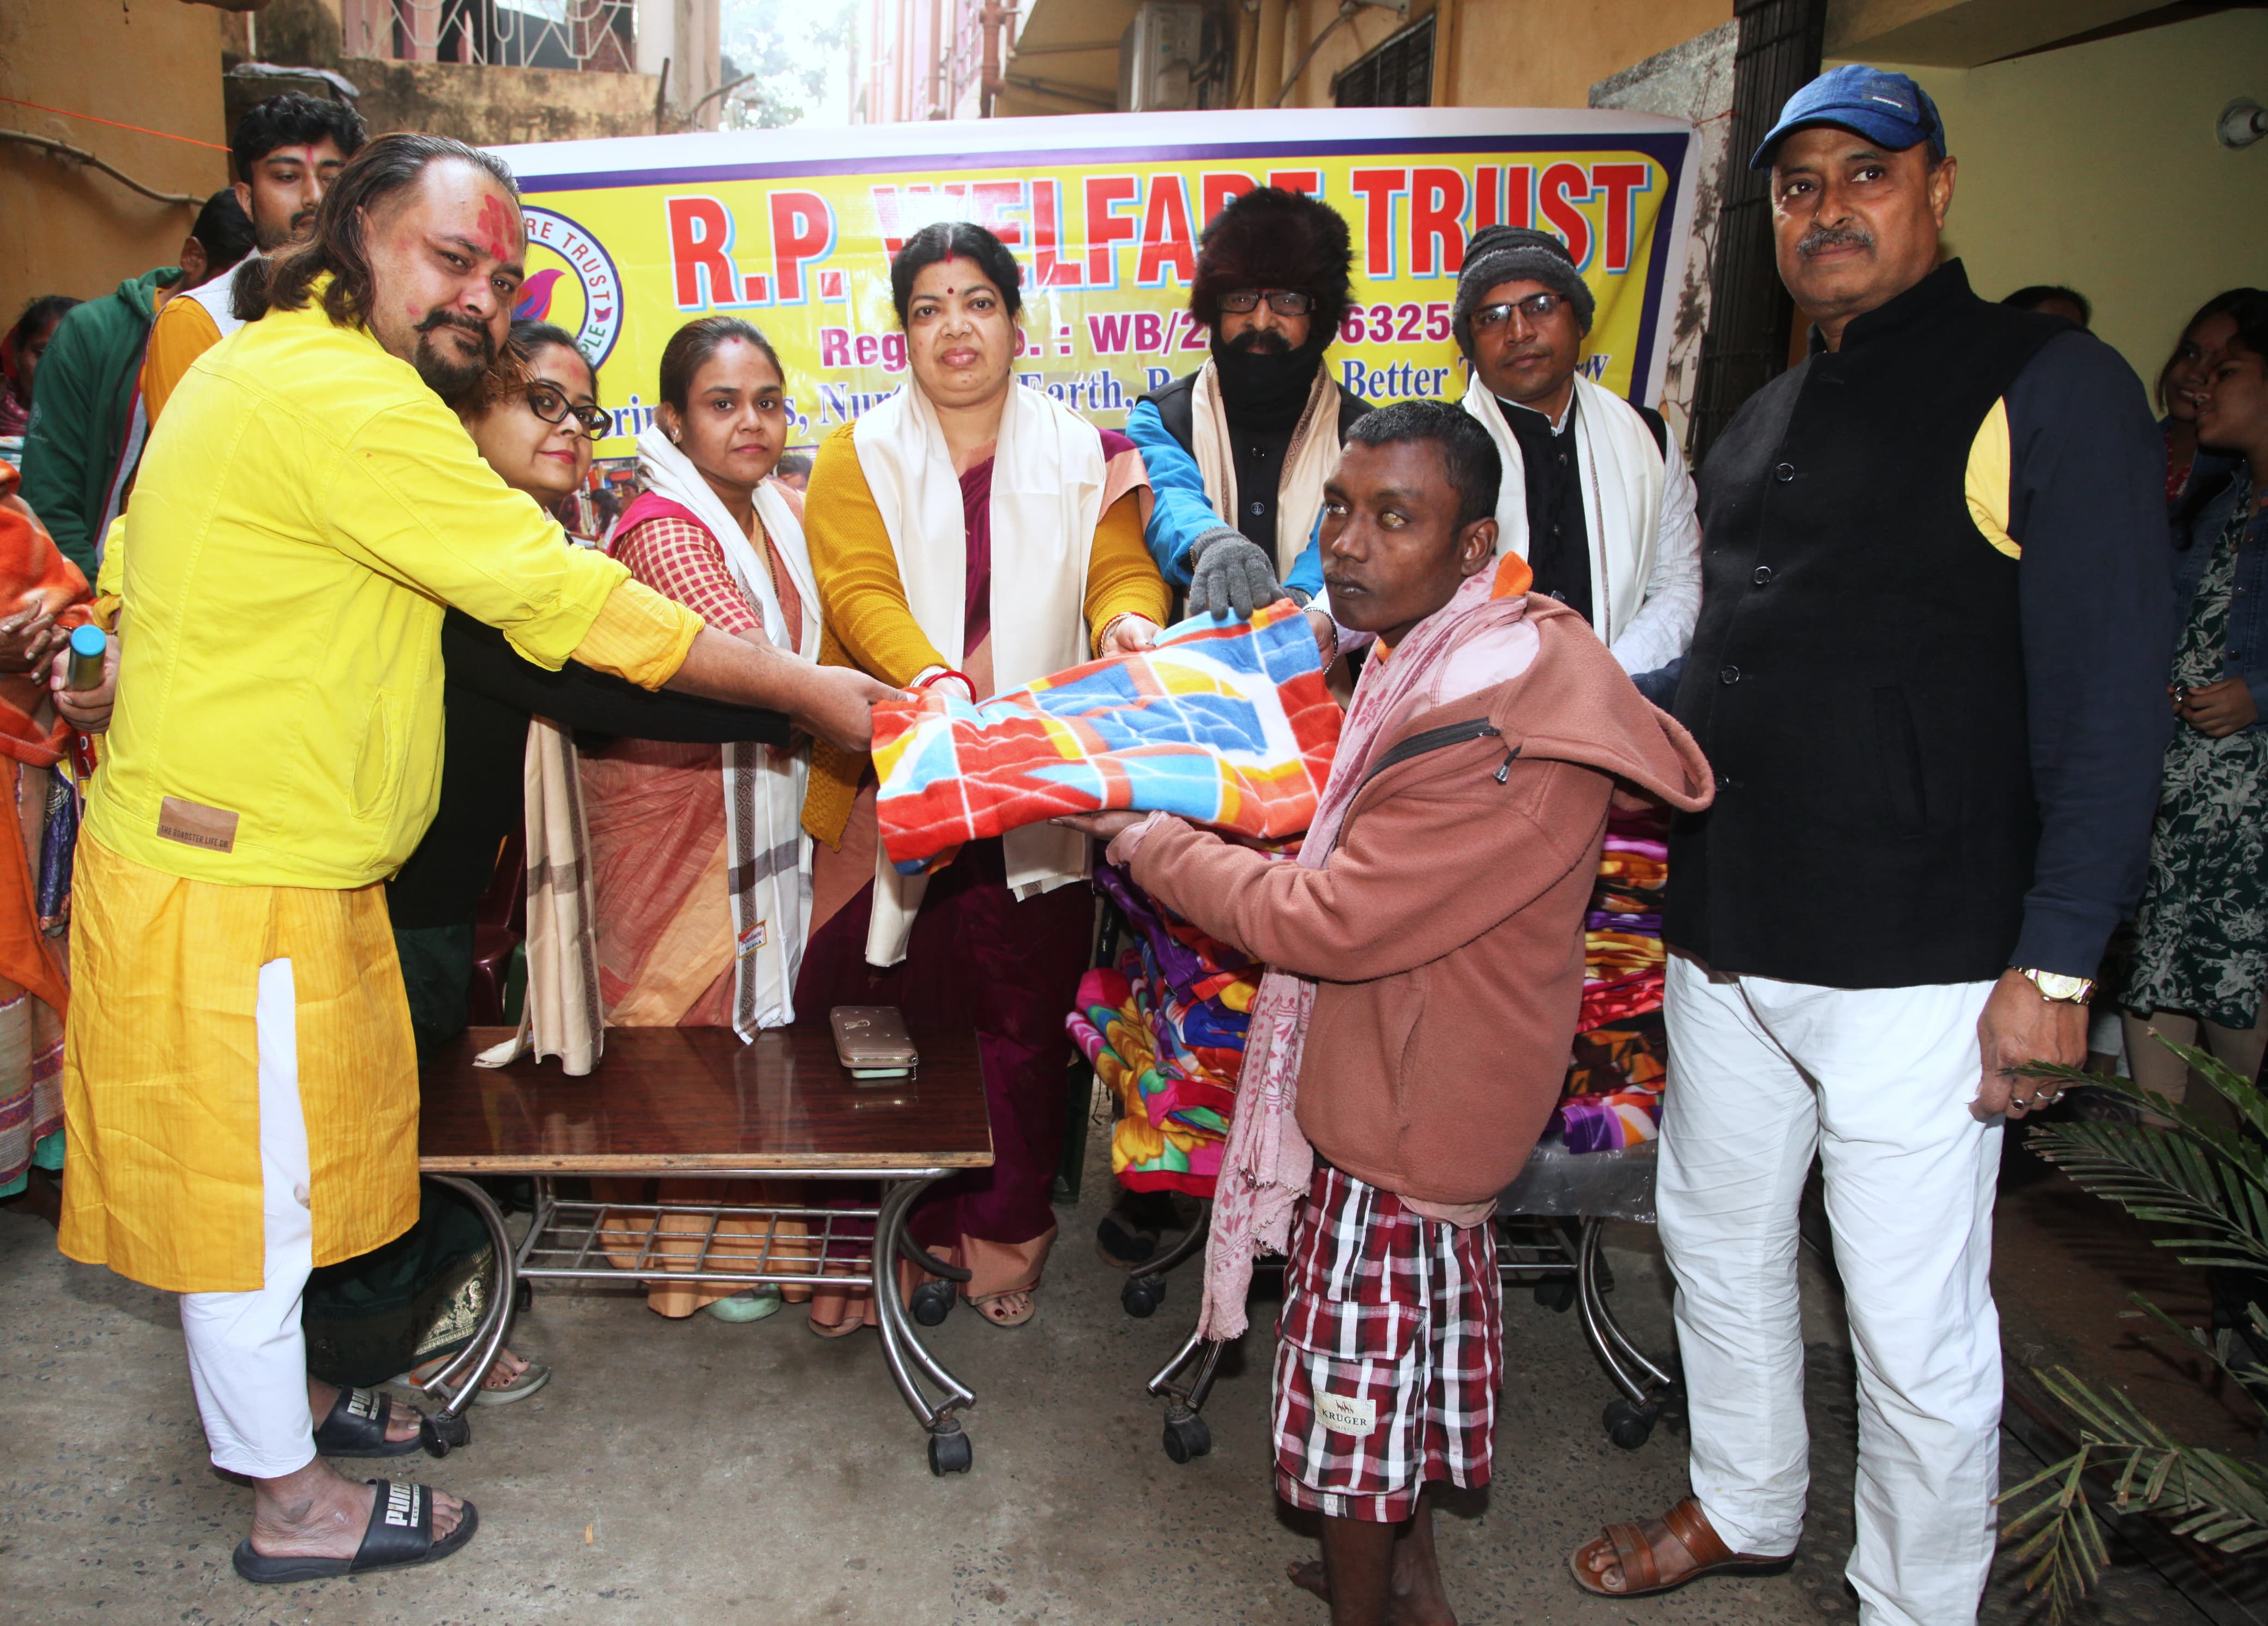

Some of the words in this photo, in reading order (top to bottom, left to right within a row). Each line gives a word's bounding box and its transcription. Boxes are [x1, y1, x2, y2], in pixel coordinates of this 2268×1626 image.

[666, 190, 845, 311] R.P.
[1350, 161, 1651, 280] TRUST
[562, 232, 611, 302] TRUST
[821, 328, 908, 373] Reg
[1341, 359, 1449, 399] Better
[161, 825, 172, 835] THE
[173, 829, 203, 844] ROADSTER
[204, 836, 218, 847] LIFE
[385, 1482, 410, 1526] PUM
